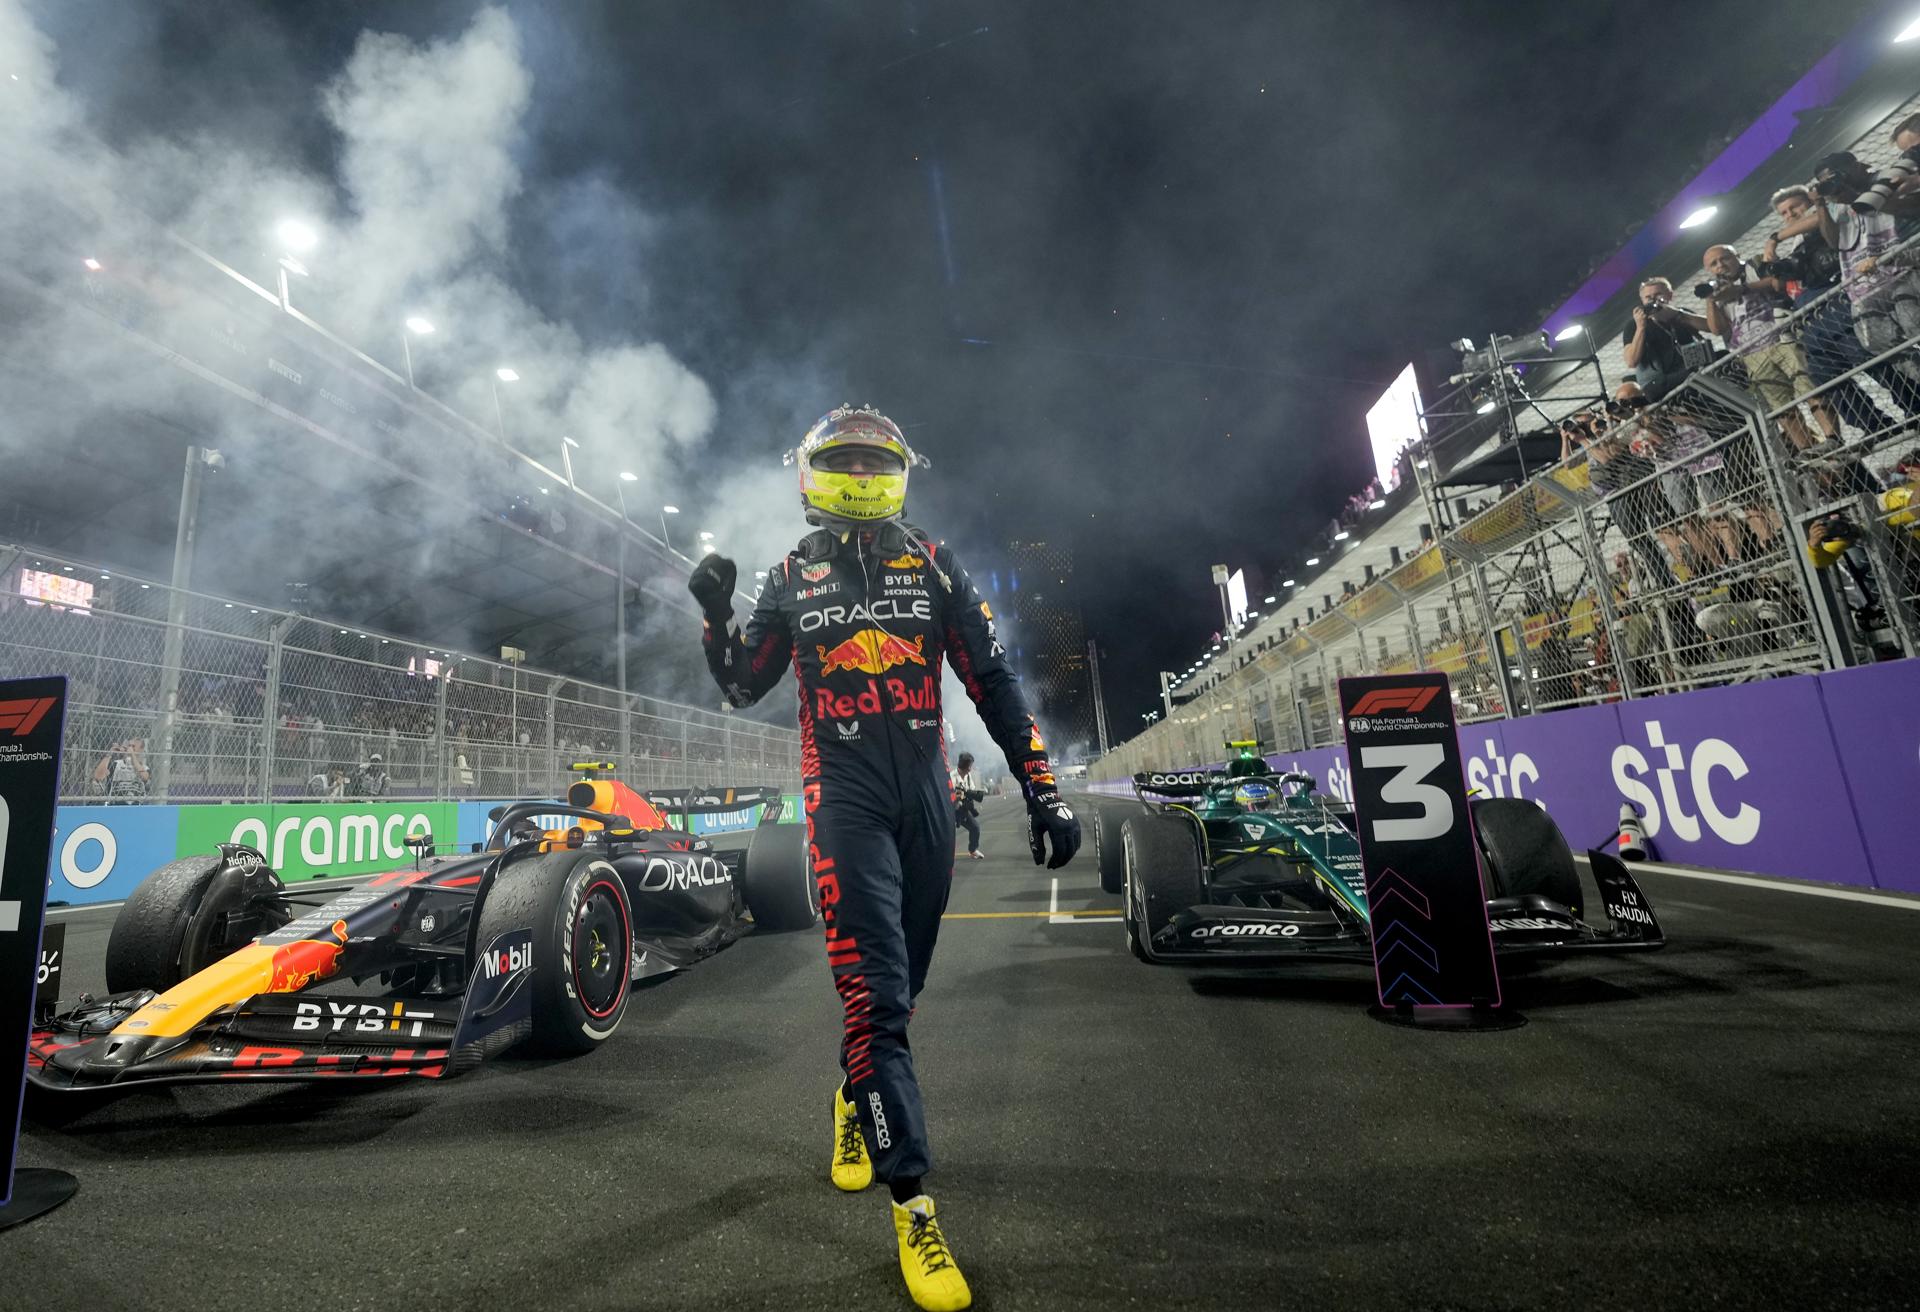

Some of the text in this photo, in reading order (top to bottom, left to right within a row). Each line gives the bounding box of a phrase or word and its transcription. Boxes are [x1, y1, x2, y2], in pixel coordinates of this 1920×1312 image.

[319, 387, 357, 415] aramco
[797, 584, 827, 600] Mobil
[883, 588, 930, 598] HONDA
[884, 572, 925, 586] BYBIT
[800, 600, 932, 632] ORACLE
[815, 676, 936, 719] Red Bull
[1372, 723, 1394, 732] World
[1360, 743, 1454, 842] 3
[1611, 720, 1761, 845] stc
[229, 813, 433, 870] aramco
[1294, 824, 1345, 836] 14
[638, 856, 732, 892] ORACLE
[1621, 890, 1638, 906] FLY
[1614, 903, 1654, 926] SAUDIA
[1191, 924, 1300, 937] aramco
[484, 942, 532, 979] Mobil
[292, 1002, 434, 1038] BYBIT
[869, 1091, 891, 1150] sparco
